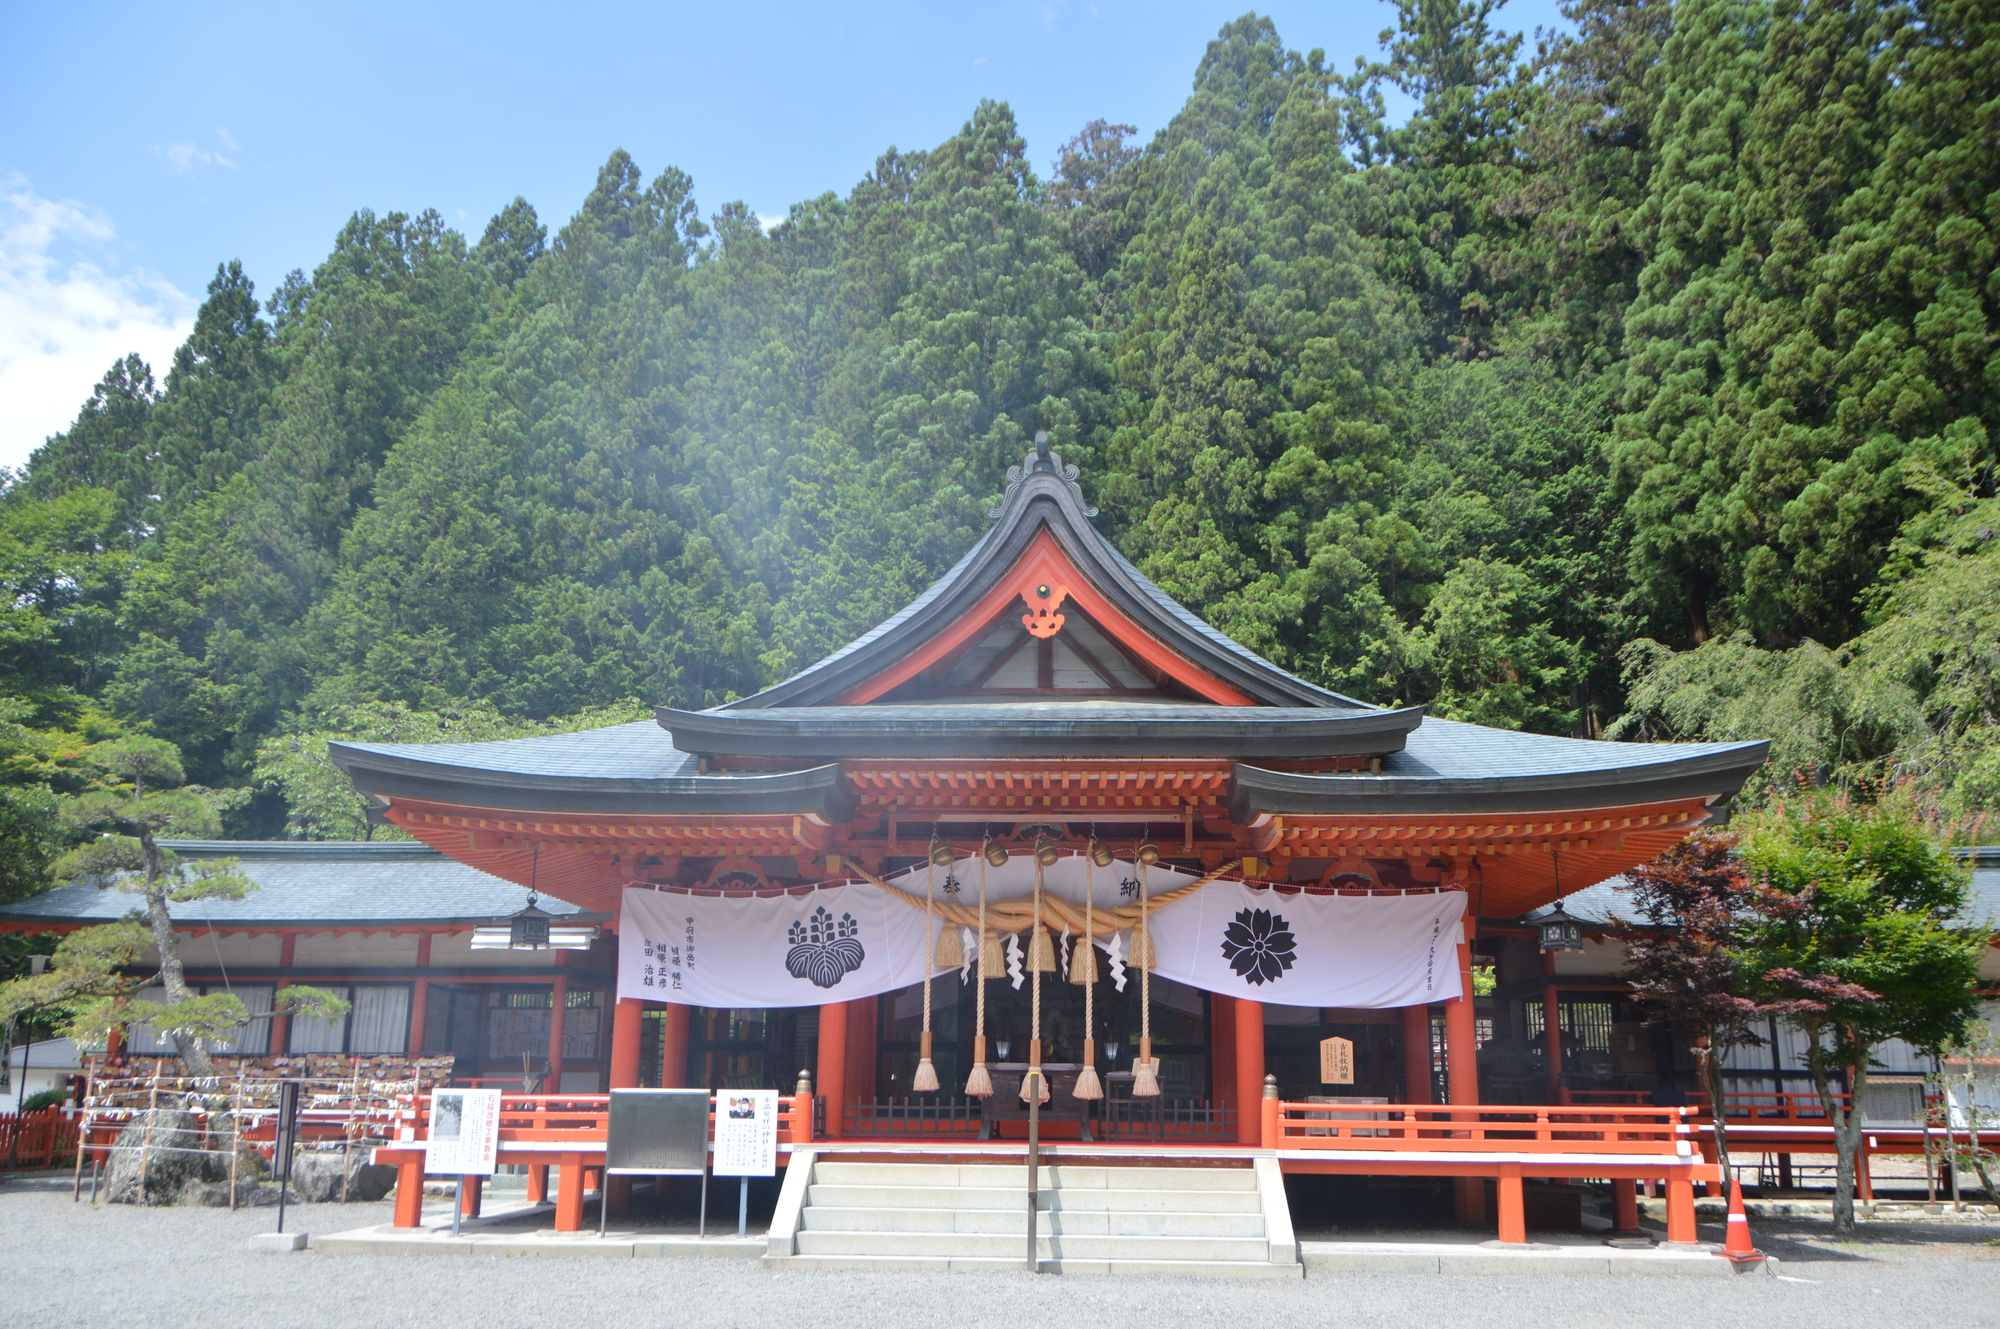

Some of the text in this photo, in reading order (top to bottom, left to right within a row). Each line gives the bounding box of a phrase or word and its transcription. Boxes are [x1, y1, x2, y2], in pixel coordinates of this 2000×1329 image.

[942, 874, 961, 895] 奉
[1120, 877, 1141, 899] 納
[686, 917, 694, 970] 甲府市御岳町
[657, 943, 667, 988] 相原 正彦
